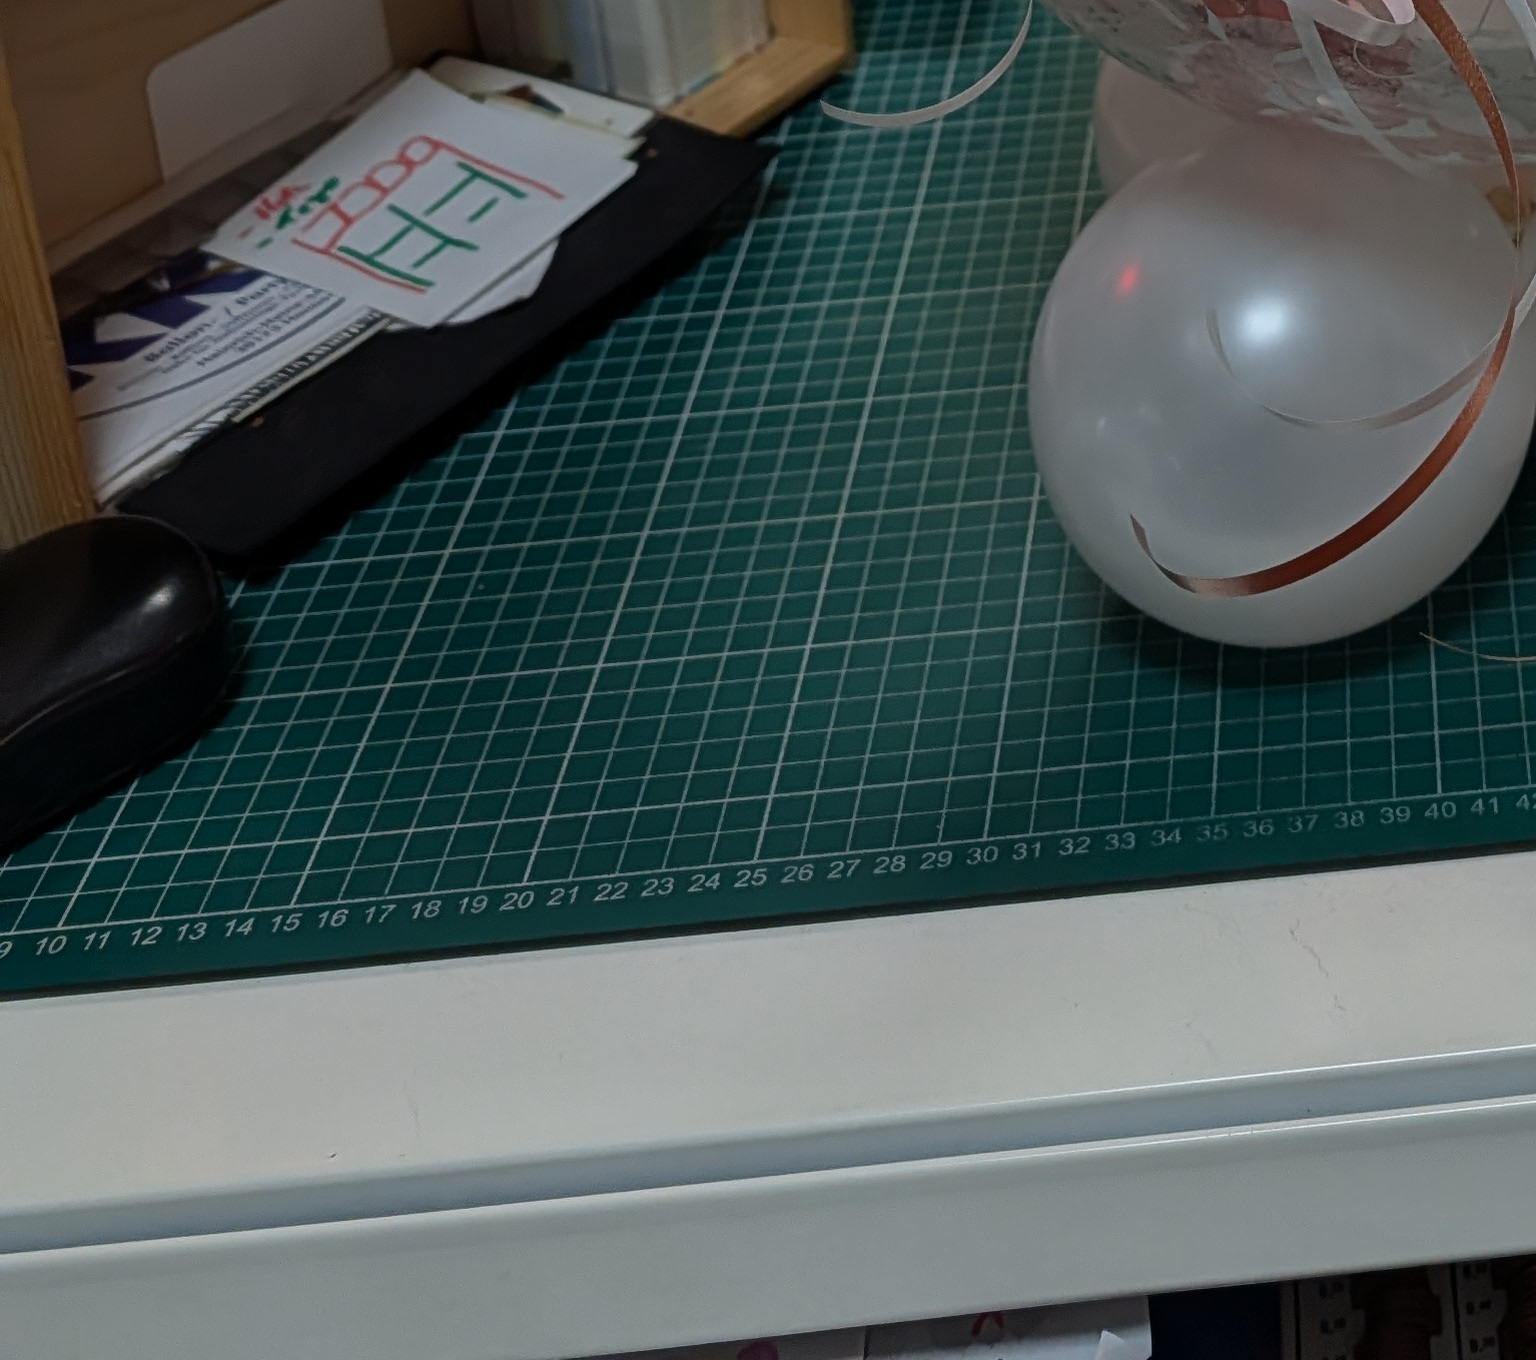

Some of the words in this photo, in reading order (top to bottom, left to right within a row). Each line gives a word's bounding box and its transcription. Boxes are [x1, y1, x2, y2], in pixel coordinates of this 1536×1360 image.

[35, 934, 70, 957] 10
[83, 929, 113, 952] 11
[130, 925, 164, 947] 12
[176, 920, 209, 942] 13
[224, 916, 256, 939] 14
[271, 912, 304, 934] 15
[317, 908, 350, 929] 16
[364, 903, 398, 924] 17
[410, 899, 443, 920] 18
[458, 894, 489, 915] 19
[498, 890, 536, 912] 20
[545, 885, 580, 907] 21
[592, 880, 629, 904] 22
[639, 876, 675, 898] 23
[686, 871, 721, 893] 24
[733, 867, 768, 889] 25
[779, 863, 816, 885] 26
[826, 858, 862, 881] 27
[872, 854, 907, 875] 28
[919, 849, 953, 871] 29
[965, 845, 999, 866] 30
[1011, 840, 1042, 861] 31
[1057, 835, 1092, 857] 32
[1104, 831, 1136, 851] 33
[1150, 827, 1182, 847] 34
[1197, 822, 1229, 840] 35
[1242, 818, 1275, 838] 36
[1287, 813, 1319, 833] 37
[1334, 809, 1365, 829] 38
[1379, 805, 1412, 825] 39
[1423, 800, 1457, 820] 40
[1469, 796, 1499, 816] 41
